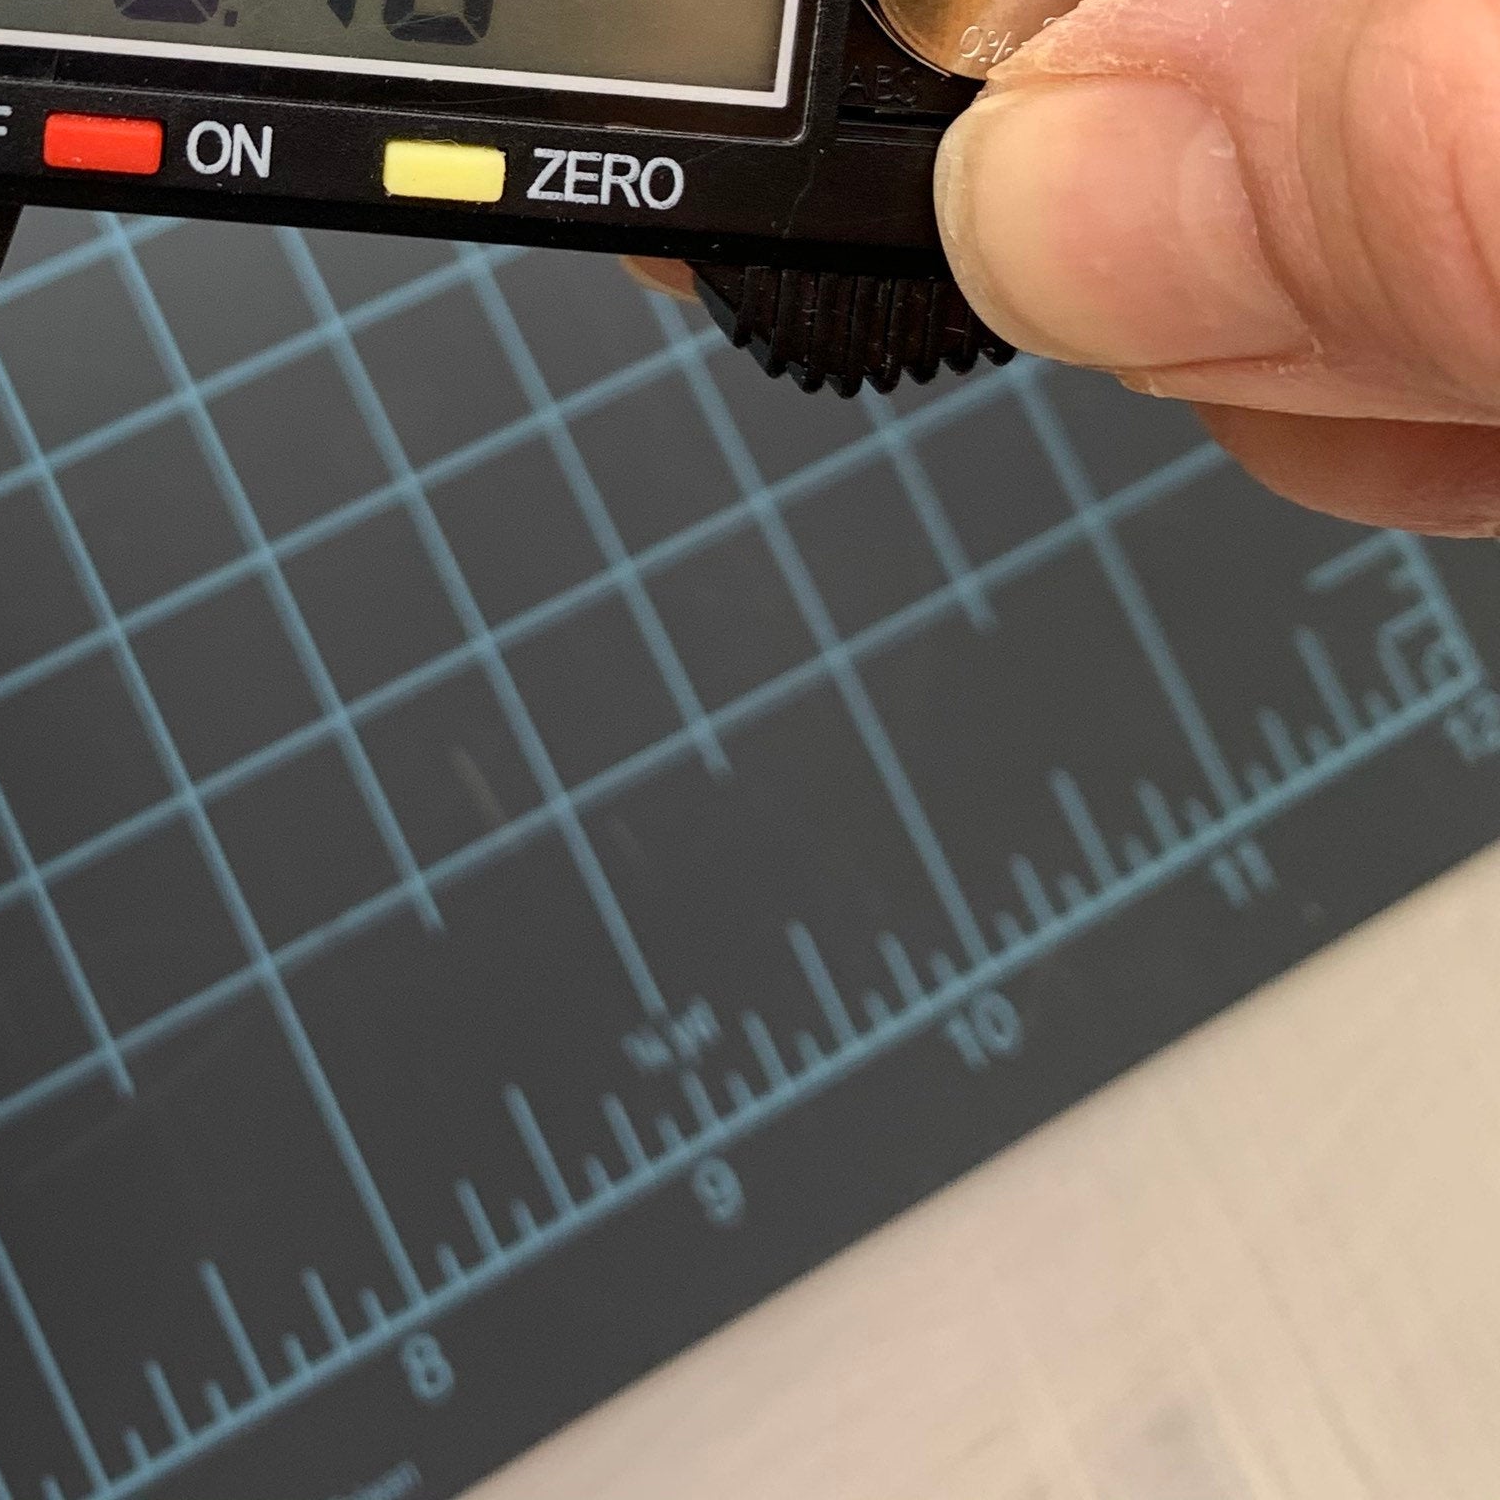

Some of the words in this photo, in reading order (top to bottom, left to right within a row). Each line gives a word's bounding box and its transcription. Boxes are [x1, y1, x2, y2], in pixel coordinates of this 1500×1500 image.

[186, 120, 273, 179] ON
[526, 147, 685, 211] ZERO
[1208, 841, 1279, 911] 11
[946, 990, 1024, 1071] 10
[693, 1156, 748, 1224] 9
[403, 1331, 456, 1404] 8
